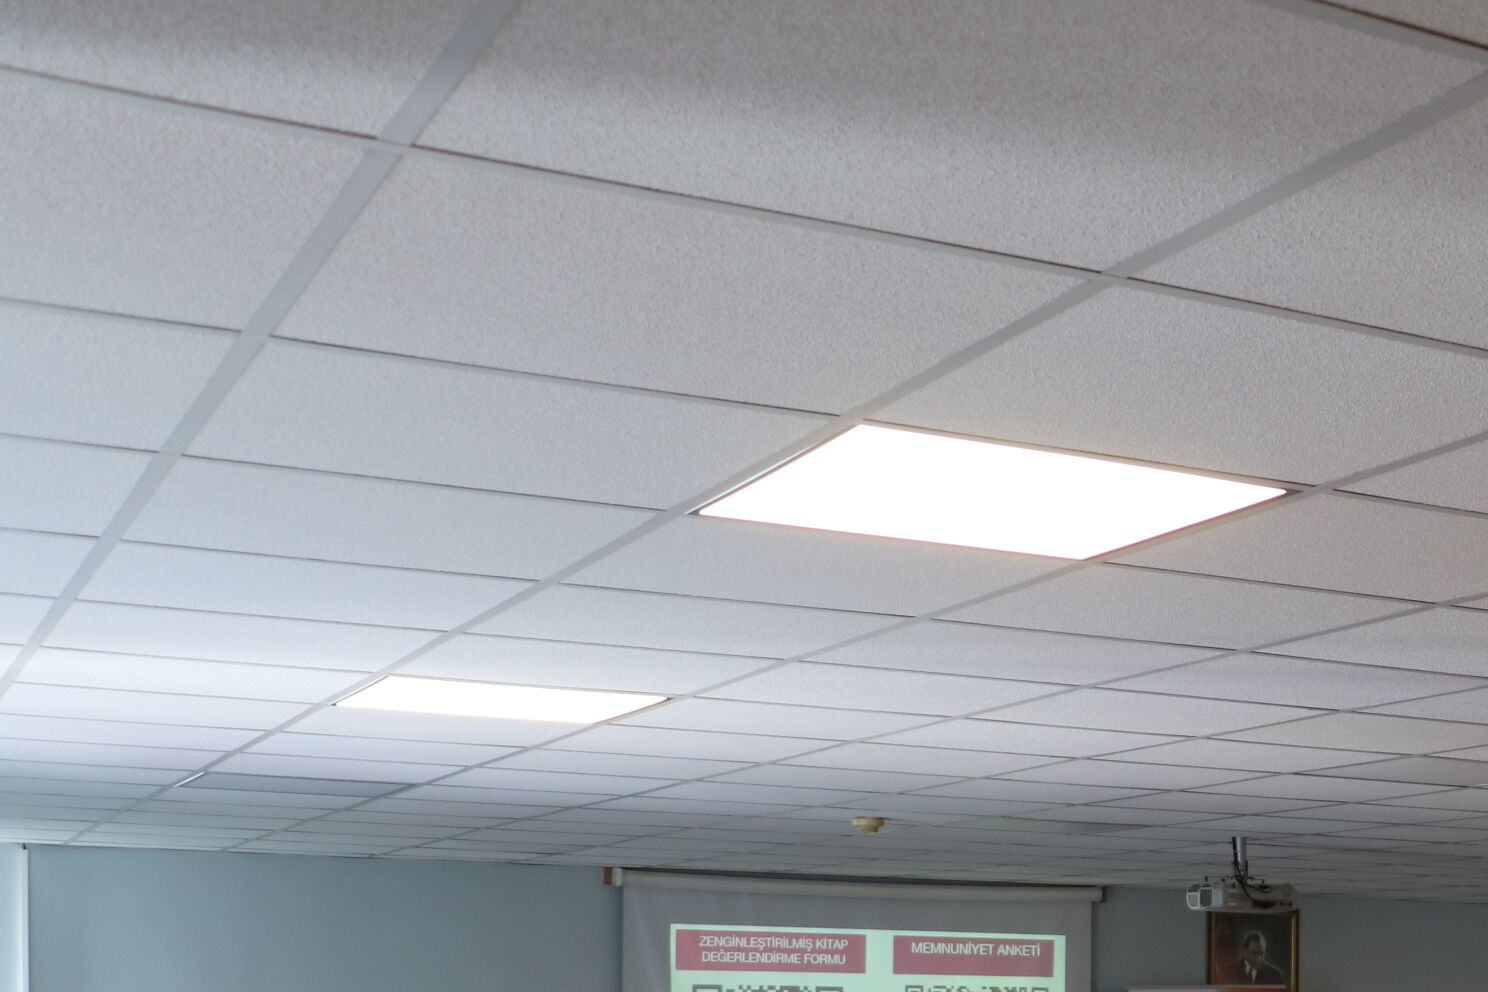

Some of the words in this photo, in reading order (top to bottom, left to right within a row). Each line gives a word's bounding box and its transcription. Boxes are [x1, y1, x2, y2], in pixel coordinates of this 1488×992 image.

[815, 937, 849, 950] KİTAP
[911, 940, 996, 956] MEMNUNİYET
[997, 942, 1041, 957] ANKETİ
[702, 949, 801, 964] DEĞERLENDİRME
[803, 953, 846, 965] FORMU
